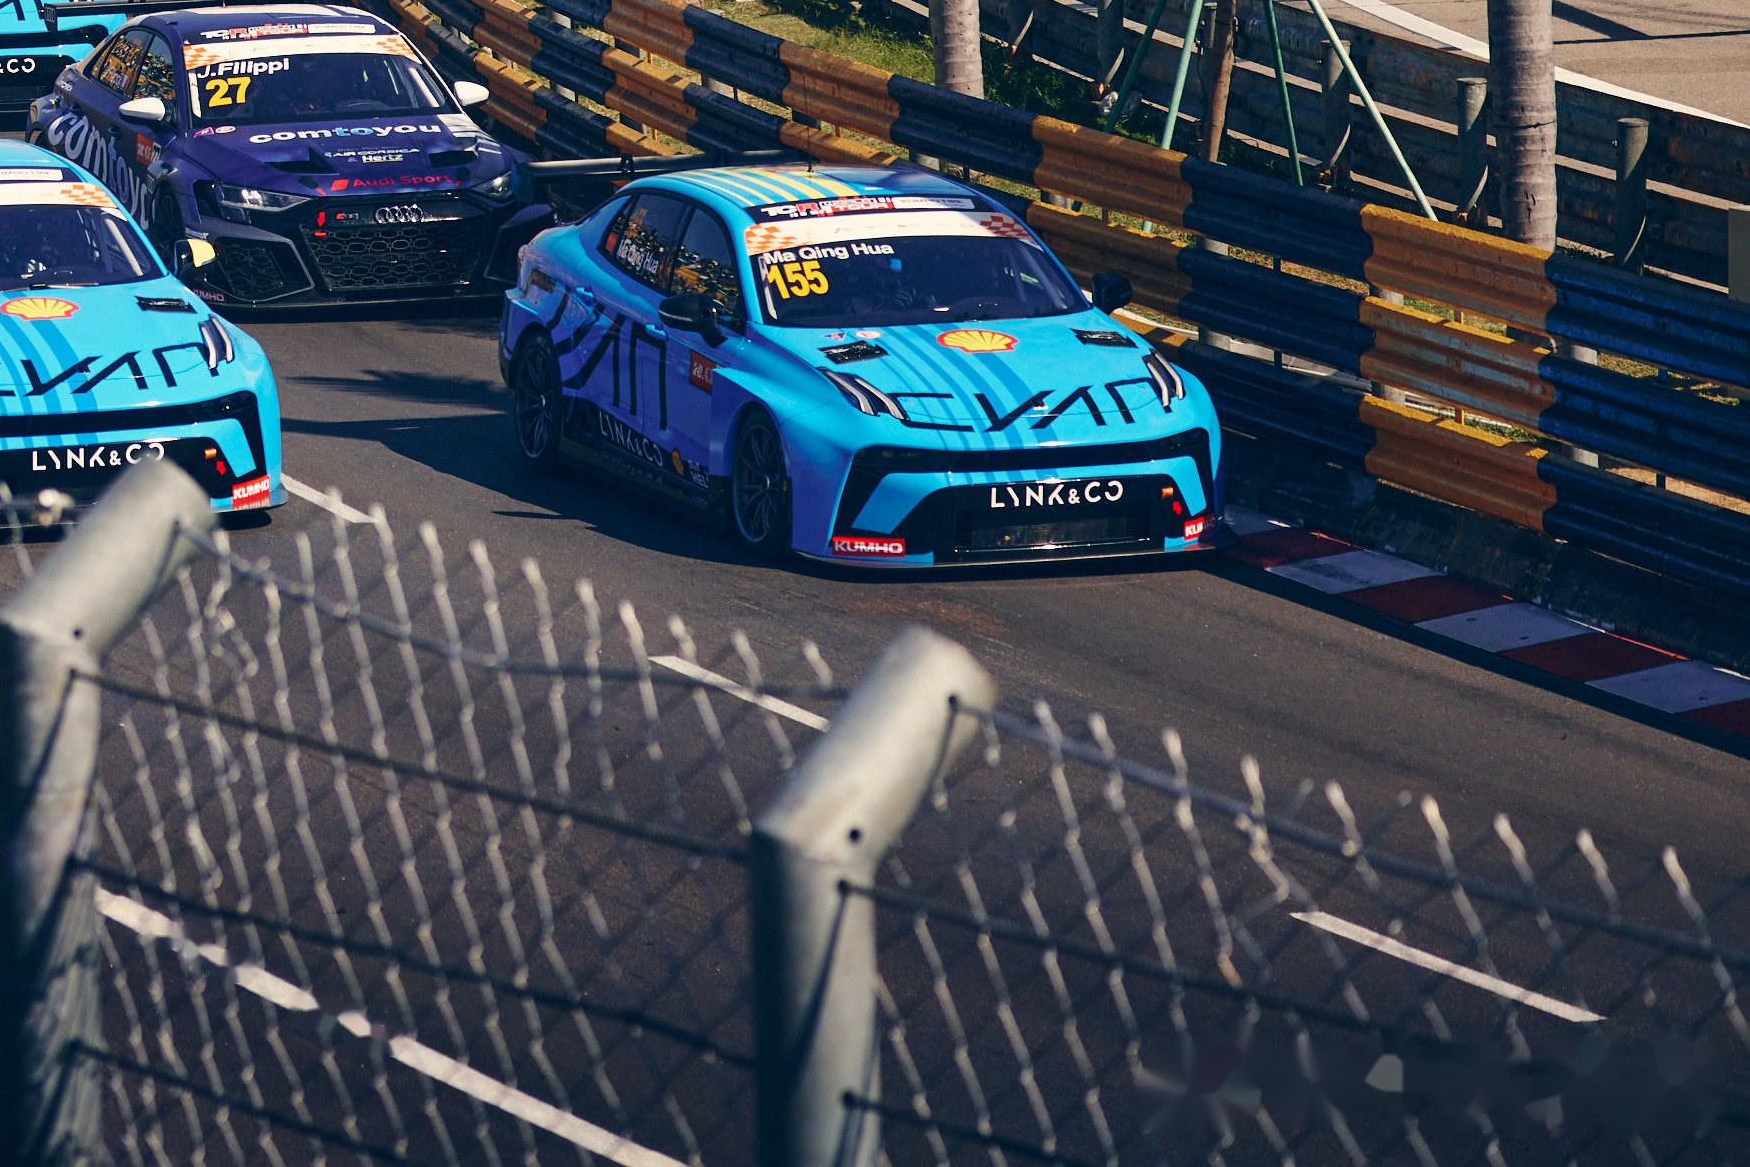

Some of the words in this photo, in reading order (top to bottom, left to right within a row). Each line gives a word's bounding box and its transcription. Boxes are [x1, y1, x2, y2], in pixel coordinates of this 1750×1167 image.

[197, 58, 290, 79] J.Filippi
[205, 76, 251, 108] 27
[249, 121, 442, 144] comtoyou
[362, 154, 404, 163] Hertz
[353, 177, 395, 188] Audi
[399, 175, 453, 186] Sport
[762, 250, 797, 266] Ma
[798, 245, 849, 261] Qing
[851, 243, 895, 257] Hua
[767, 258, 830, 300] 155
[233, 478, 270, 500] KUMHO
[833, 539, 906, 556] KUMHO
